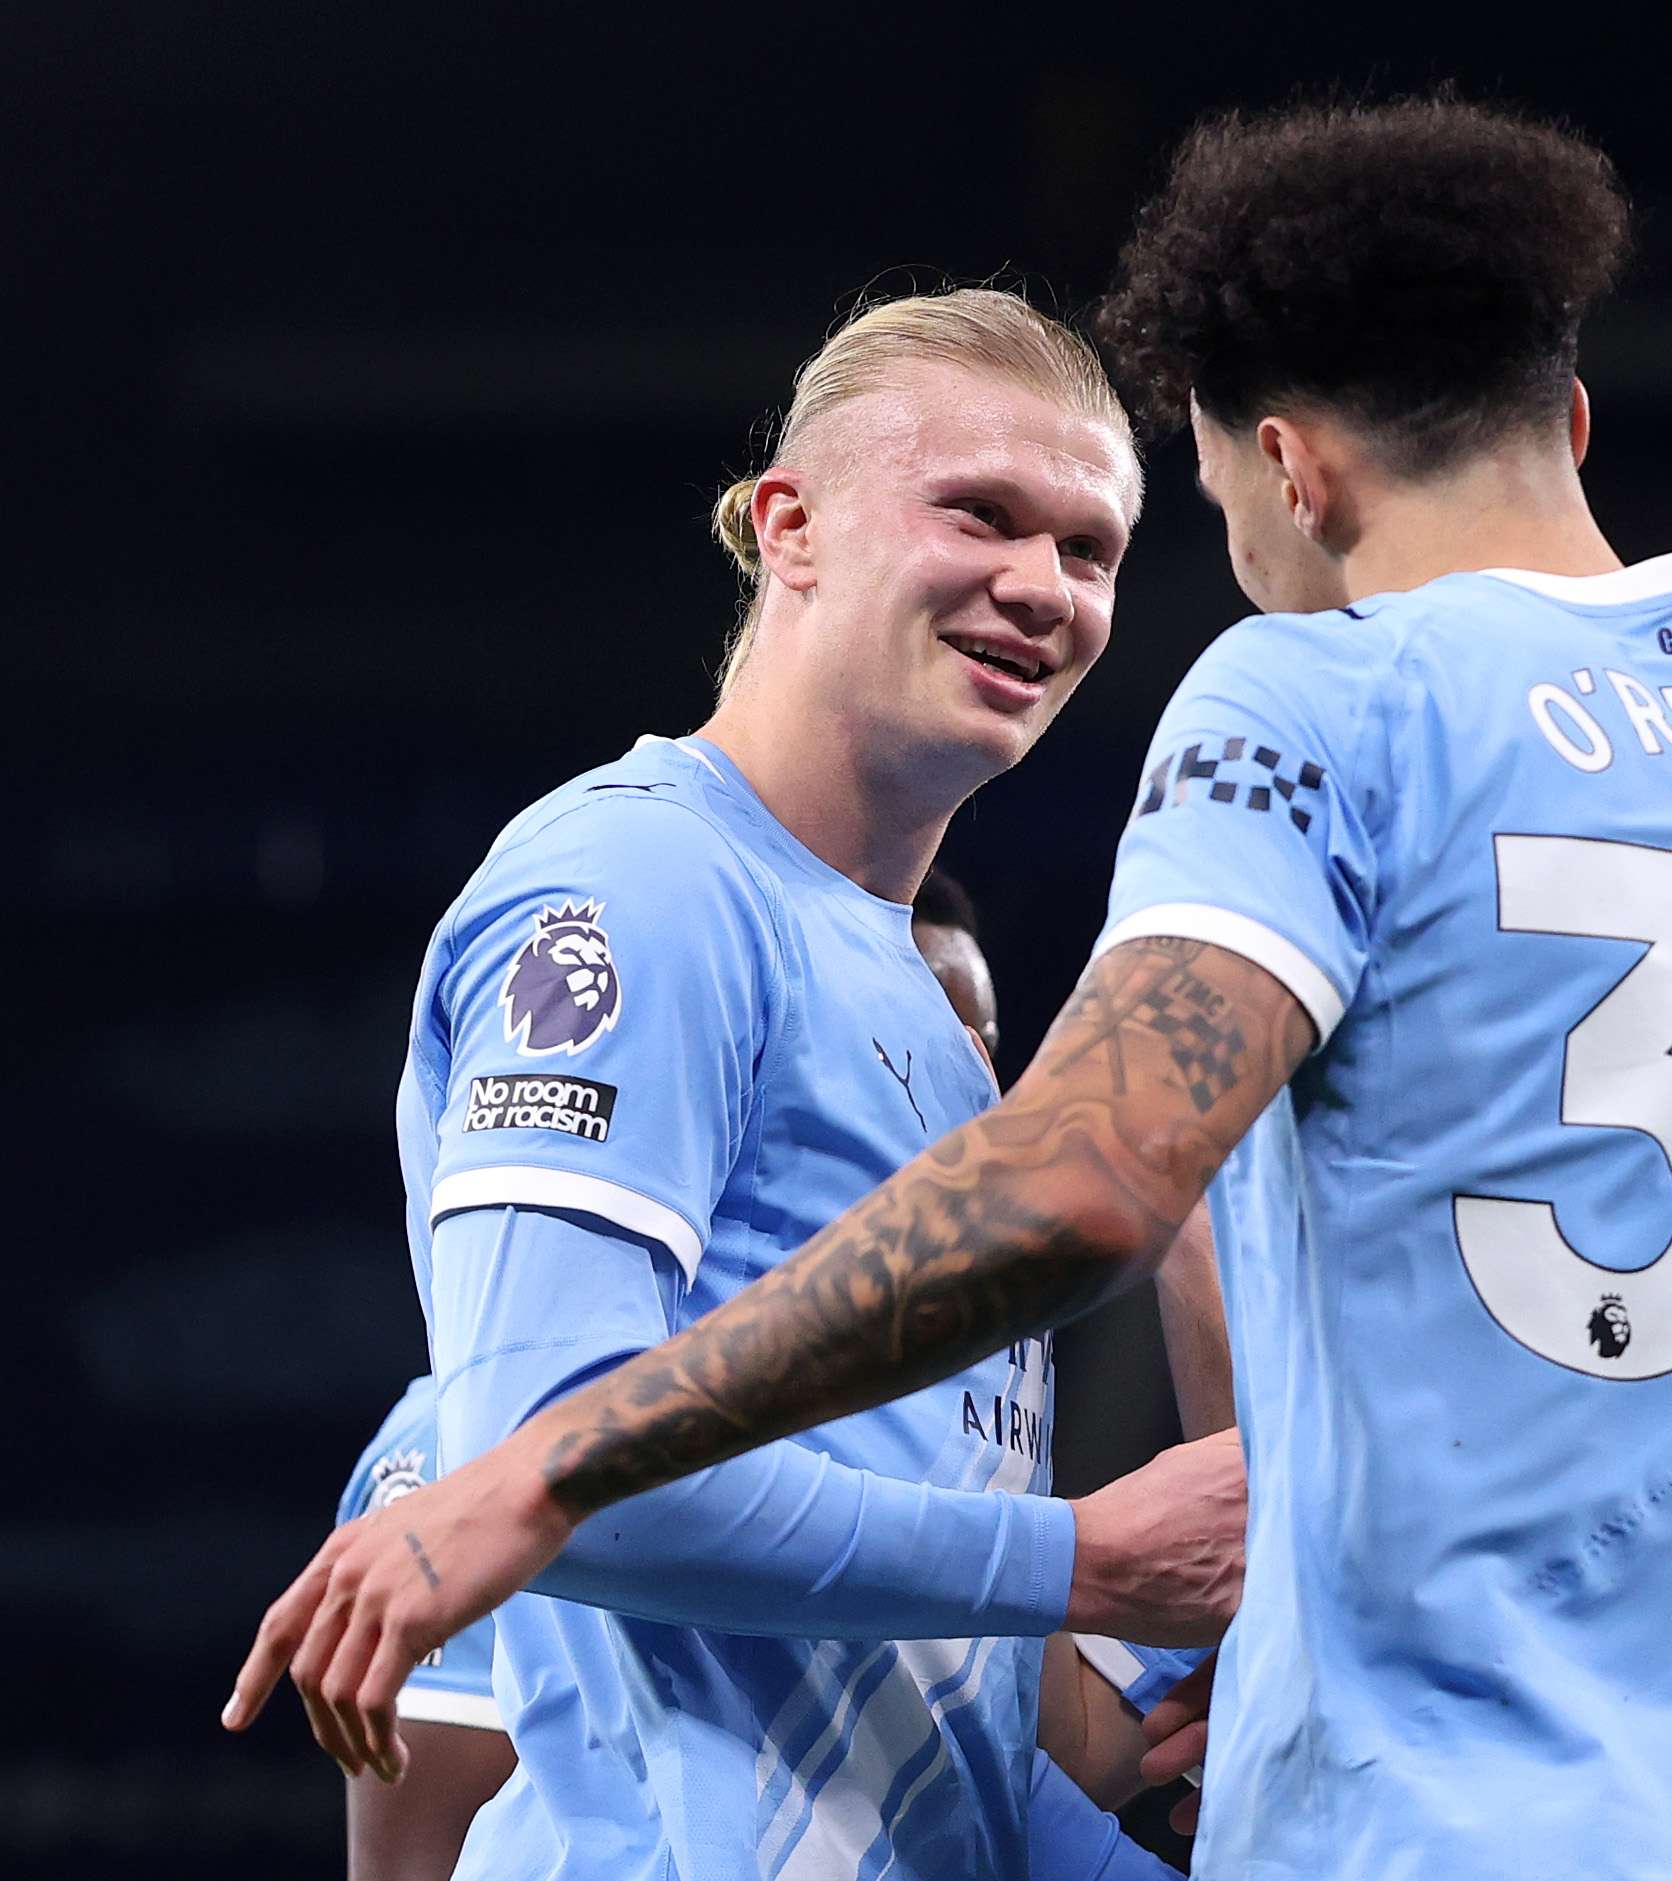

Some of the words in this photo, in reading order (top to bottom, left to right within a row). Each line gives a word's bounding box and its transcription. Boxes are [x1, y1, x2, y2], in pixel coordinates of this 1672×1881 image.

[470, 1077, 509, 1106] No
[511, 1080, 600, 1113] room
[462, 1103, 505, 1133] for
[503, 1105, 608, 1142] racism
[962, 1389, 1051, 1470] AIRW
